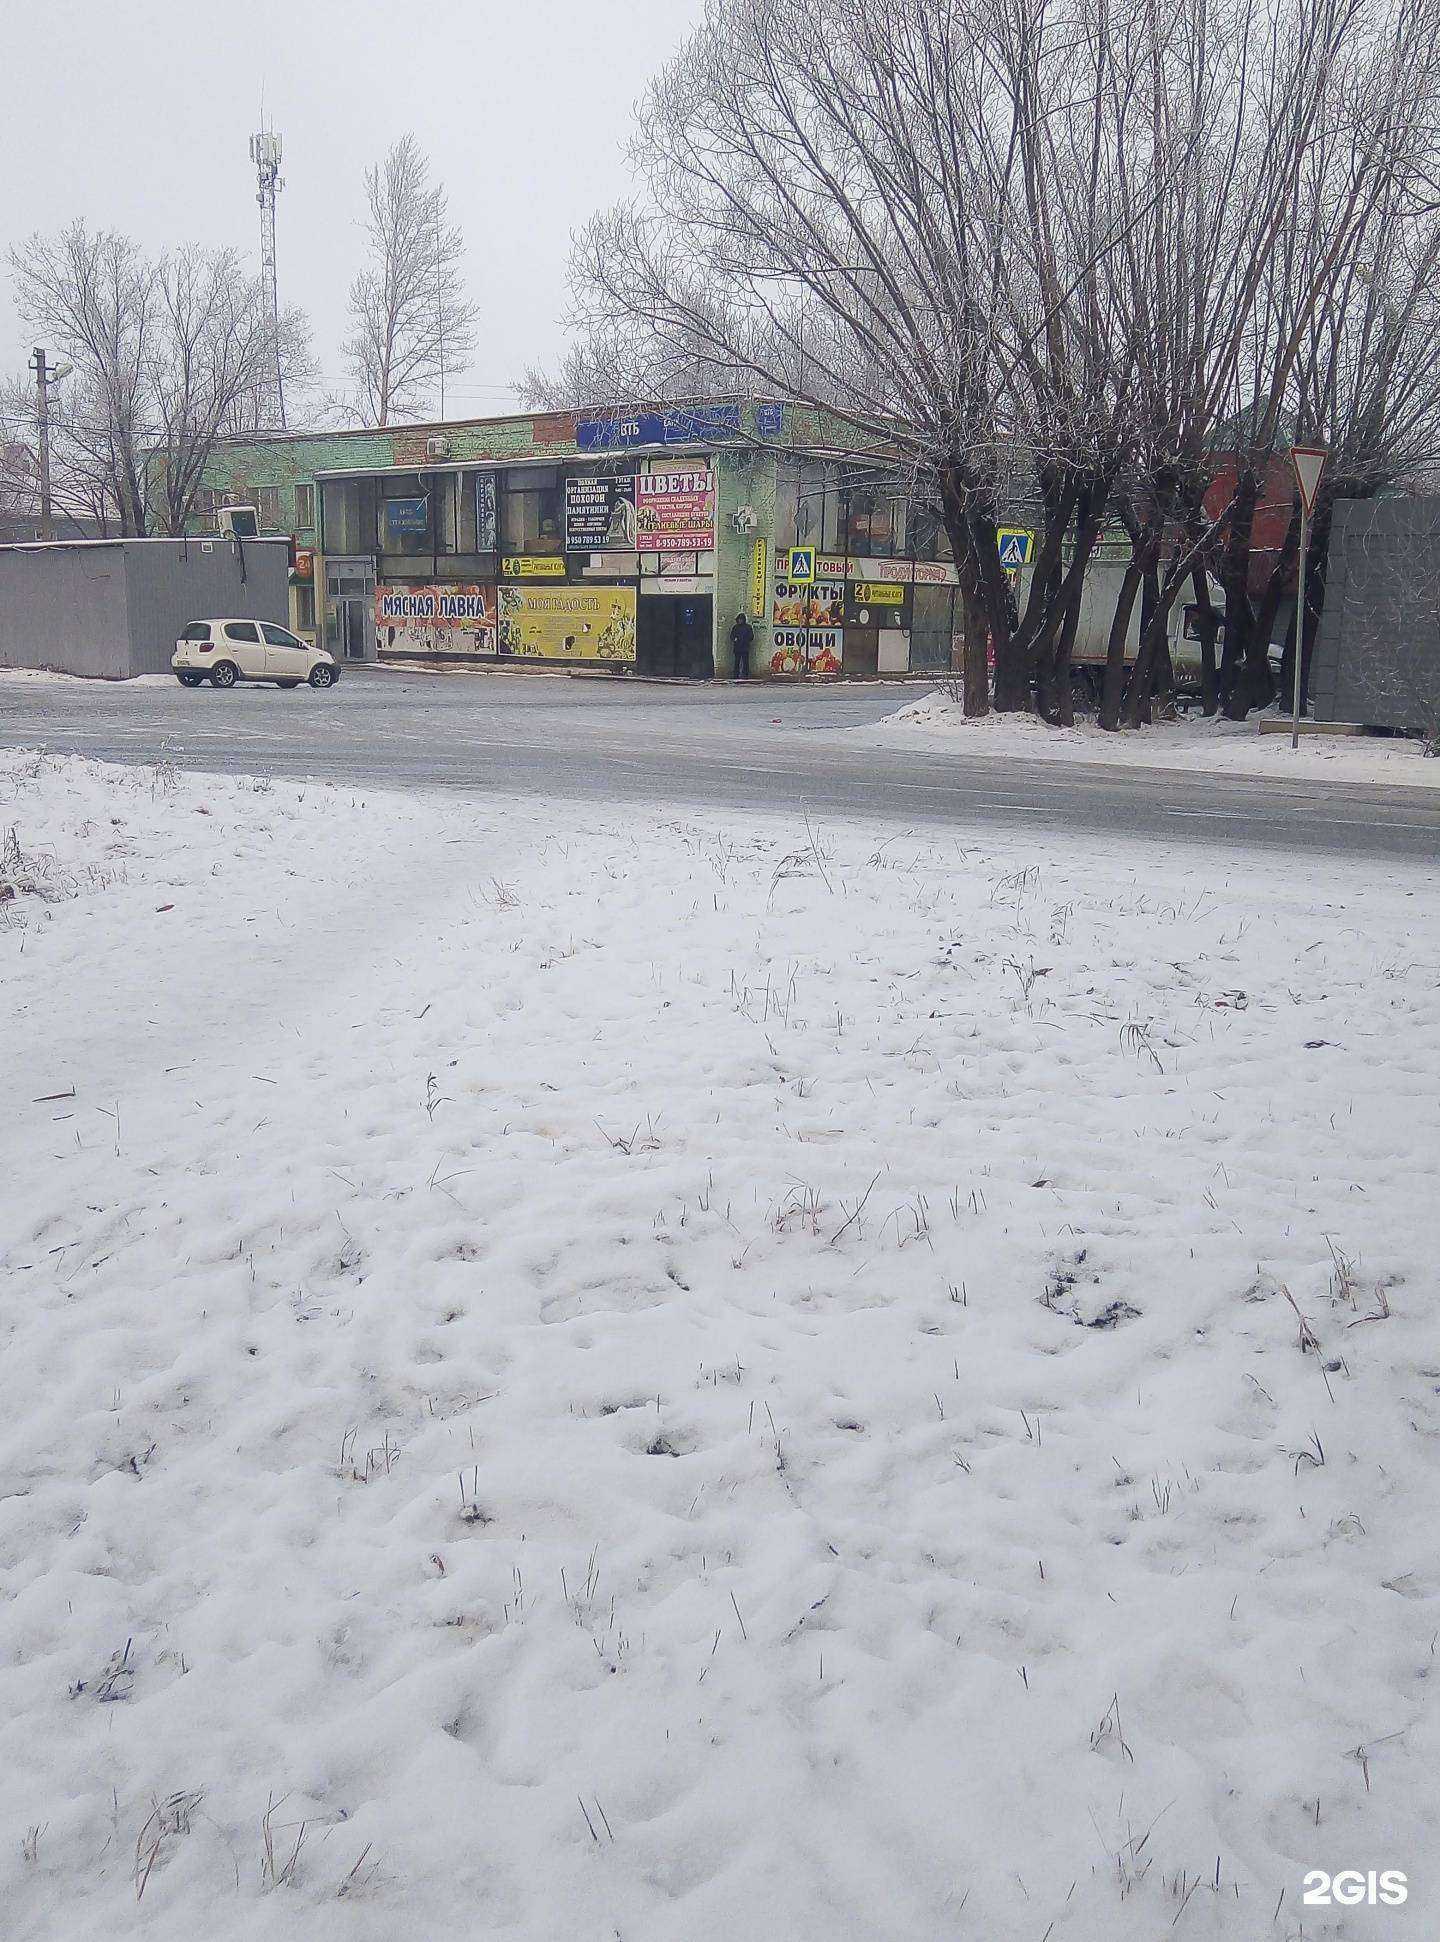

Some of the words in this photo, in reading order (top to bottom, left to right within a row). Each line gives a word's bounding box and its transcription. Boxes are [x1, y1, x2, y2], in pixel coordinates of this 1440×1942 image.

[620, 422, 639, 436] ВТБ
[567, 485, 609, 493] ОРГАНИЗАЦИЯ
[640, 472, 713, 495] ЦВЕТЫ
[570, 494, 605, 503] ПОХОРОН
[567, 506, 609, 514] ПАМЯТНИКИ
[688, 520, 713, 528] ШАРЫ
[571, 536, 581, 544] 950
[602, 535, 610, 543] 19
[656, 538, 712, 547] 8-950-789-53-19
[504, 559, 511, 570] 2
[776, 583, 844, 600] ФРУКТЫ
[856, 584, 863, 595] 2
[382, 595, 434, 617] МЯСНАЯ
[438, 595, 486, 617] ЛАВКА
[527, 598, 550, 610] МОЯ
[551, 598, 600, 612] РАДОСТЬ
[774, 631, 836, 650] ОВОЩИ
